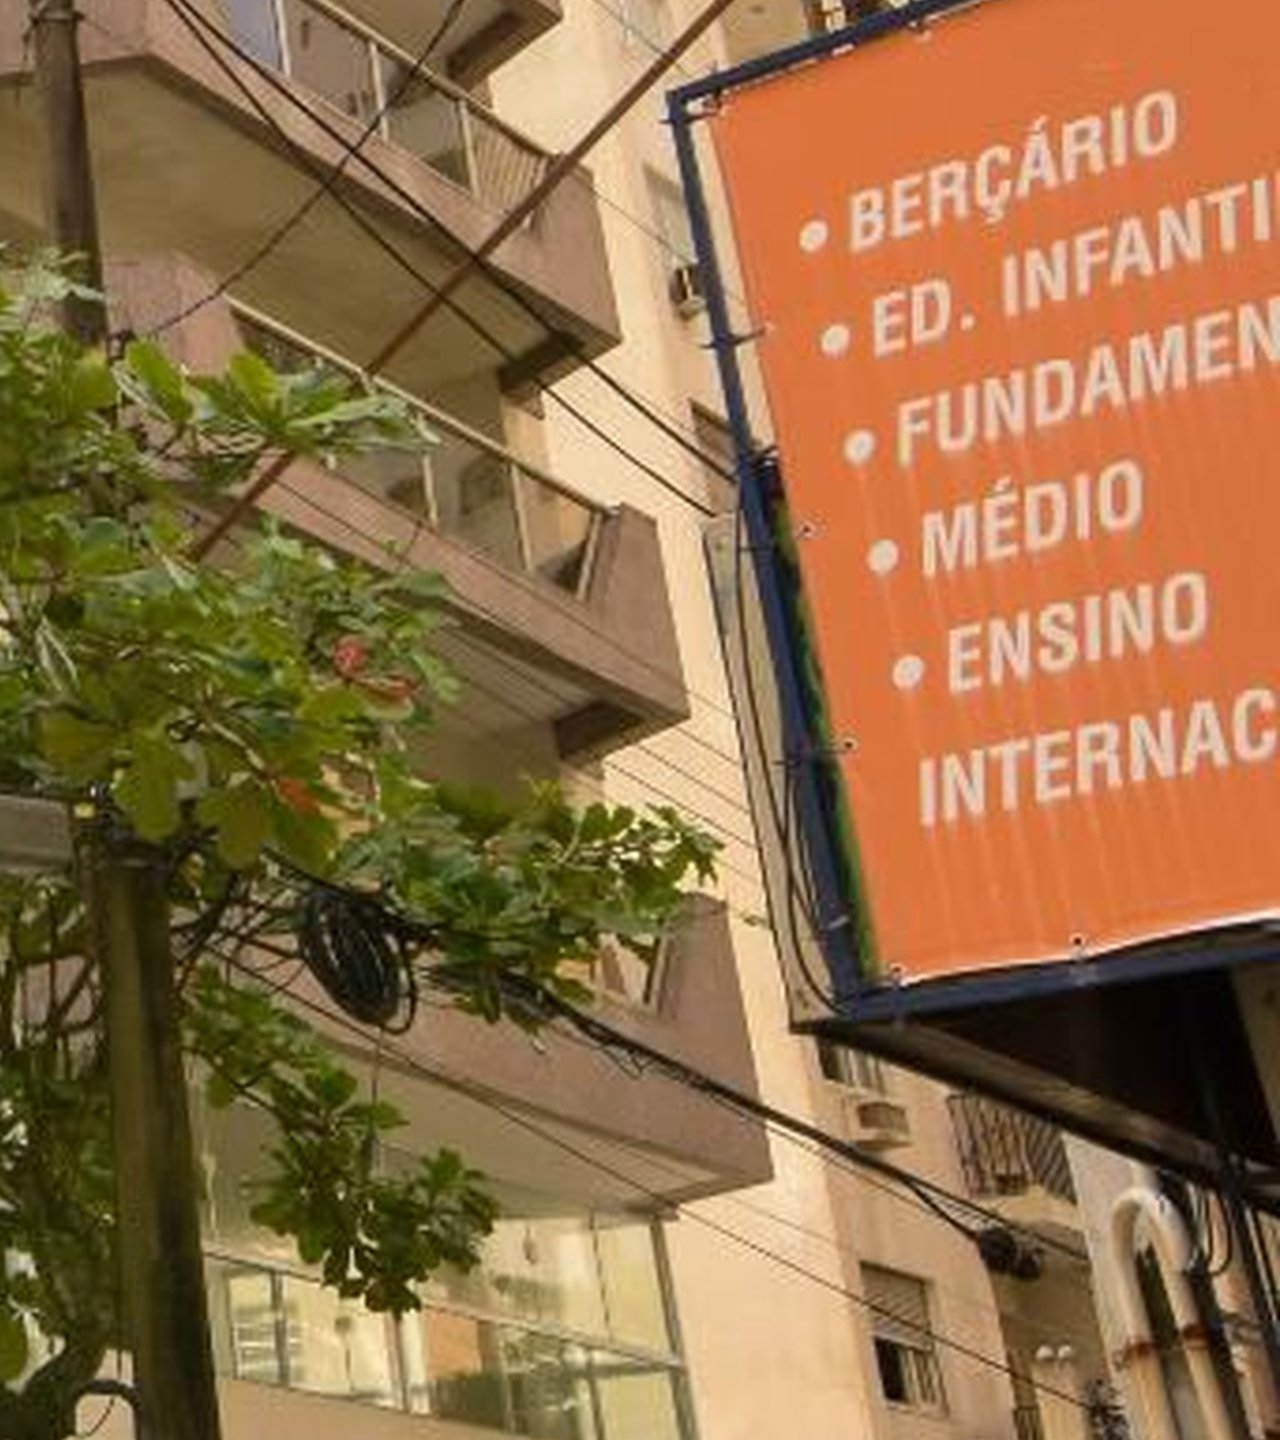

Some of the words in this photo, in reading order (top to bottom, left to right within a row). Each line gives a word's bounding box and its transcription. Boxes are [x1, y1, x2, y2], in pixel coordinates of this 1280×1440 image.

[849, 90, 1180, 254] BERÇÁRIO
[872, 278, 976, 358] ED.
[1002, 172, 1280, 318] INFANTI
[921, 460, 1142, 578] MÉDIO
[948, 572, 1207, 692] ENSINO
[918, 688, 1278, 828] INTERNAC
